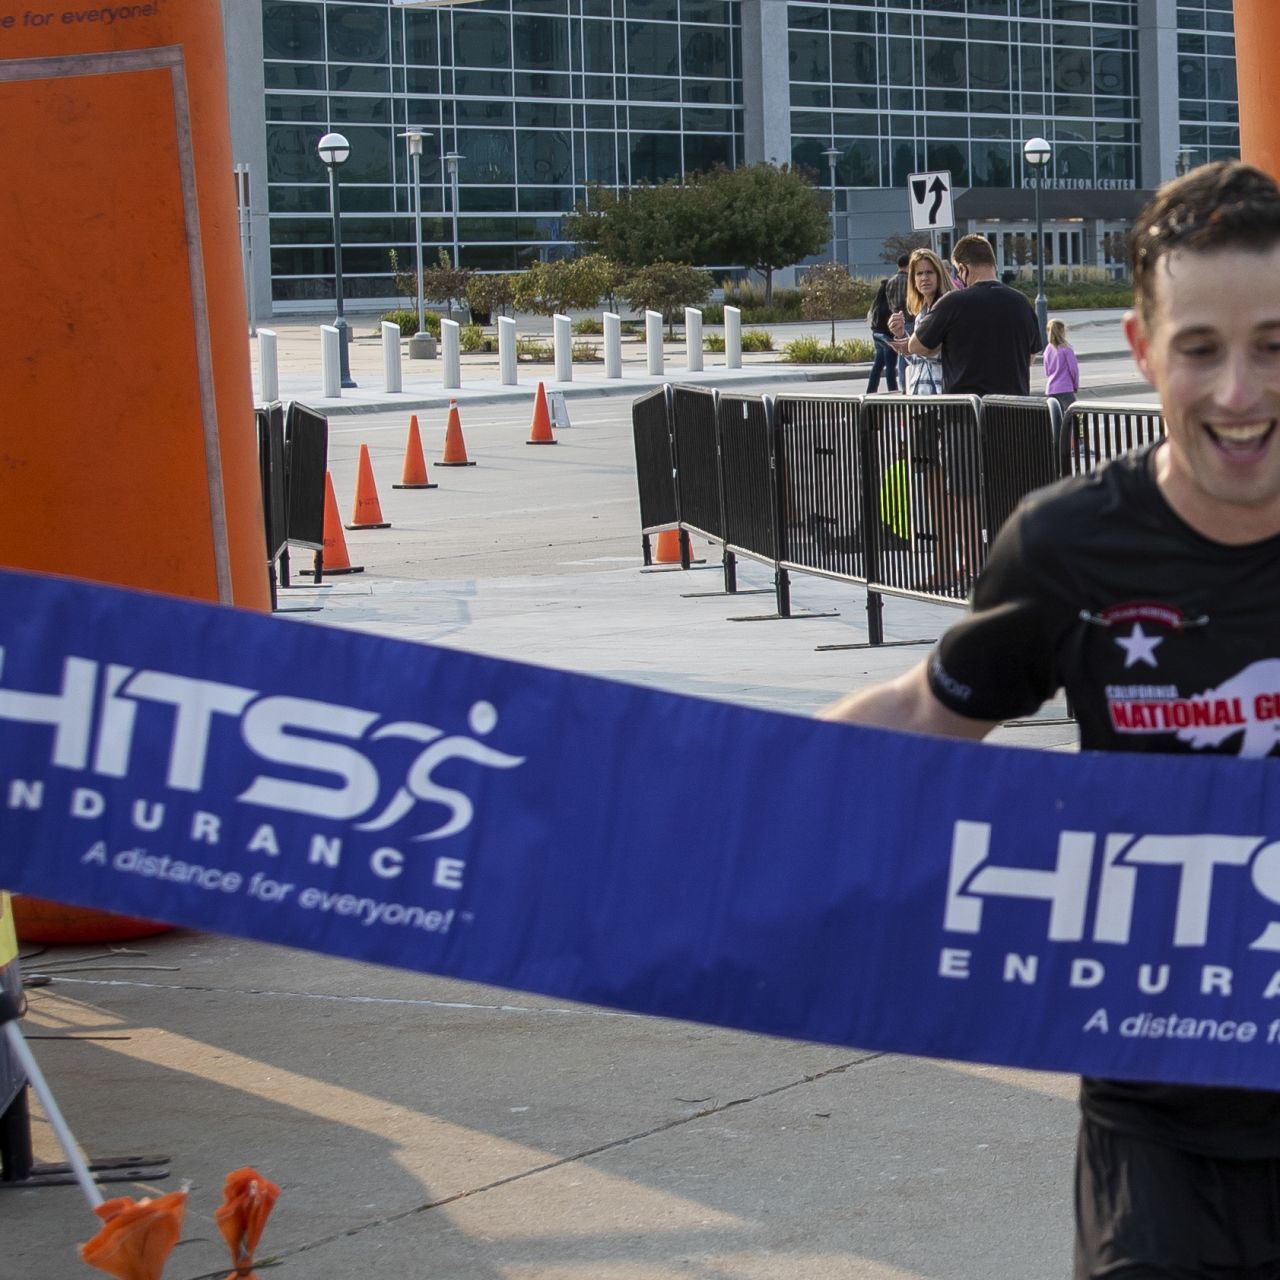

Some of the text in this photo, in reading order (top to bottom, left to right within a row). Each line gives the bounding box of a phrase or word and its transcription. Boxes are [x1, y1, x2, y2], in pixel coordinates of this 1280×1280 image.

[23, 10, 54, 27] for
[1097, 178, 1136, 190] CENTER
[1110, 697, 1247, 730] NATIONAL
[82, 840, 107, 866] A
[114, 847, 242, 893] distance
[247, 871, 295, 903] for
[1084, 1008, 1109, 1033] A
[1119, 1011, 1258, 1044] distance
